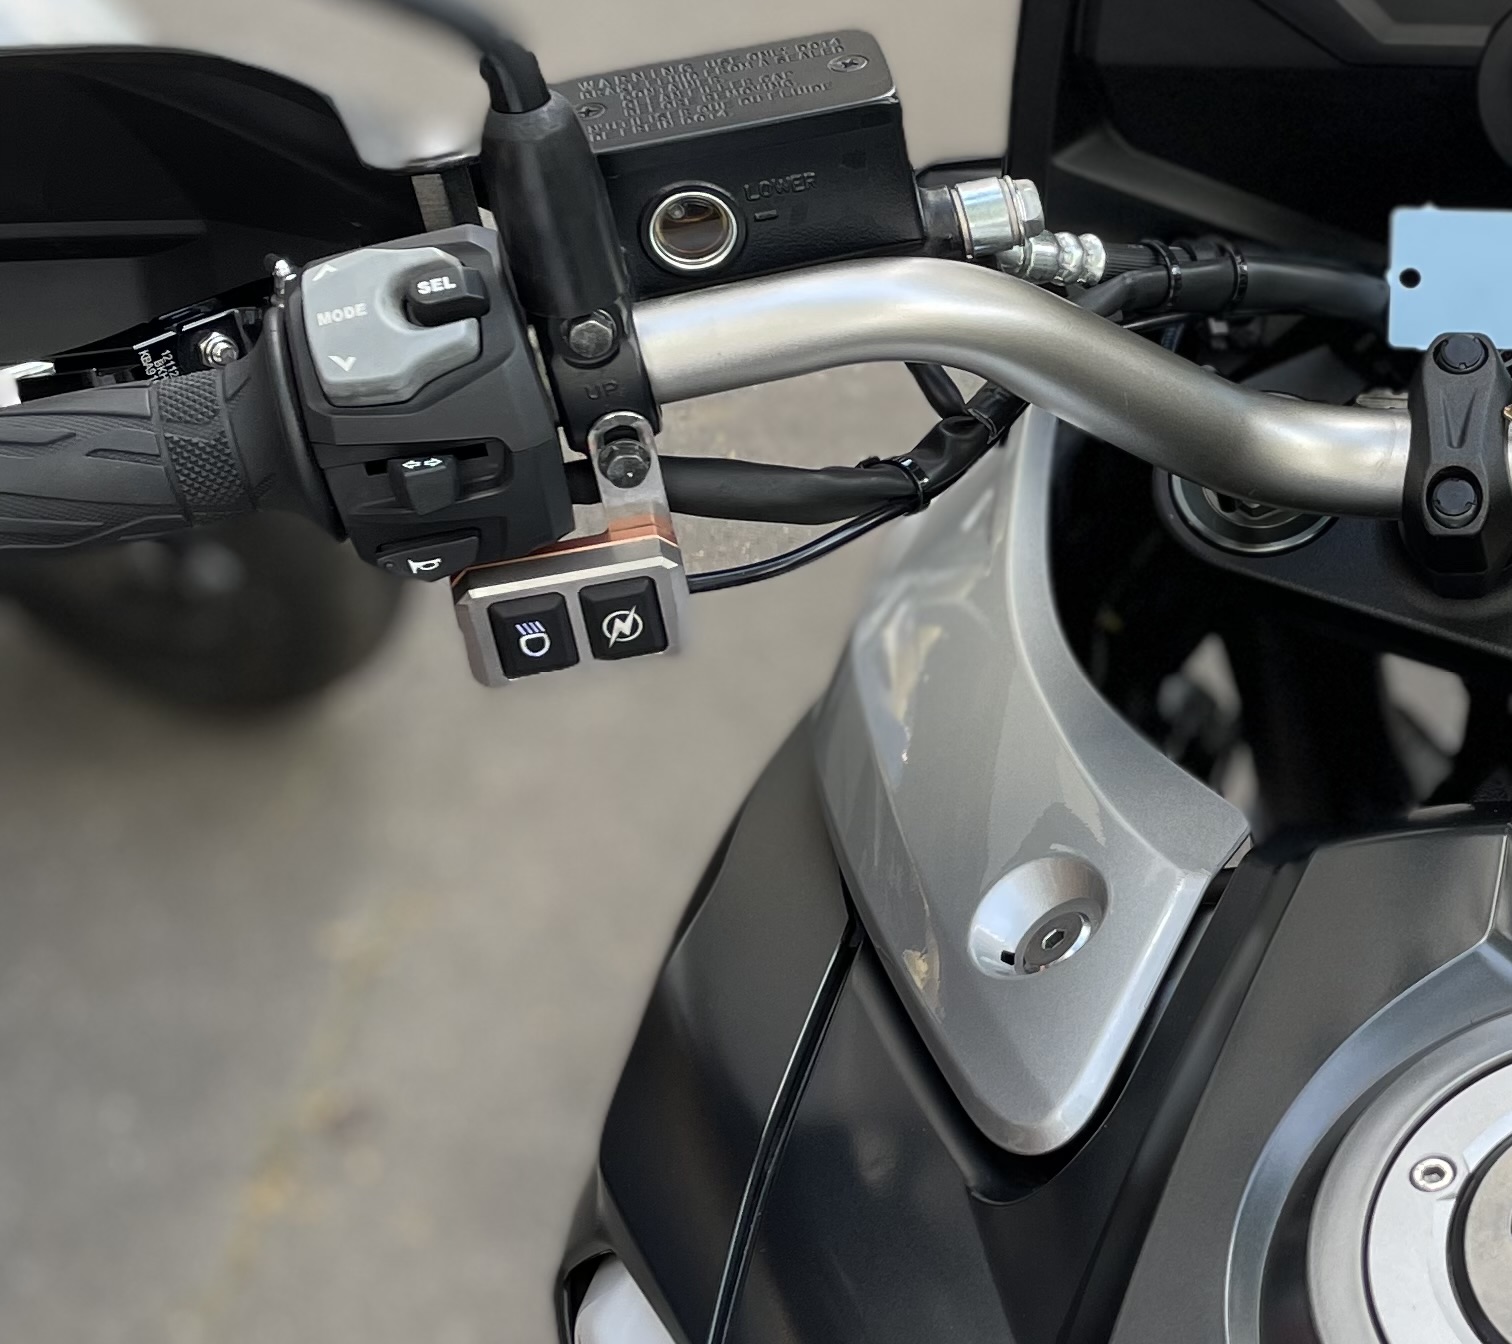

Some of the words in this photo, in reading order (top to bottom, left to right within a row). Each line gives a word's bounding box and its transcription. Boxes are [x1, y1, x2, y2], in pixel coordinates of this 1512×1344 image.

[743, 171, 816, 202] LOWER
[416, 276, 457, 295] SEL
[316, 303, 368, 326] MODE
[584, 380, 618, 401] UP
